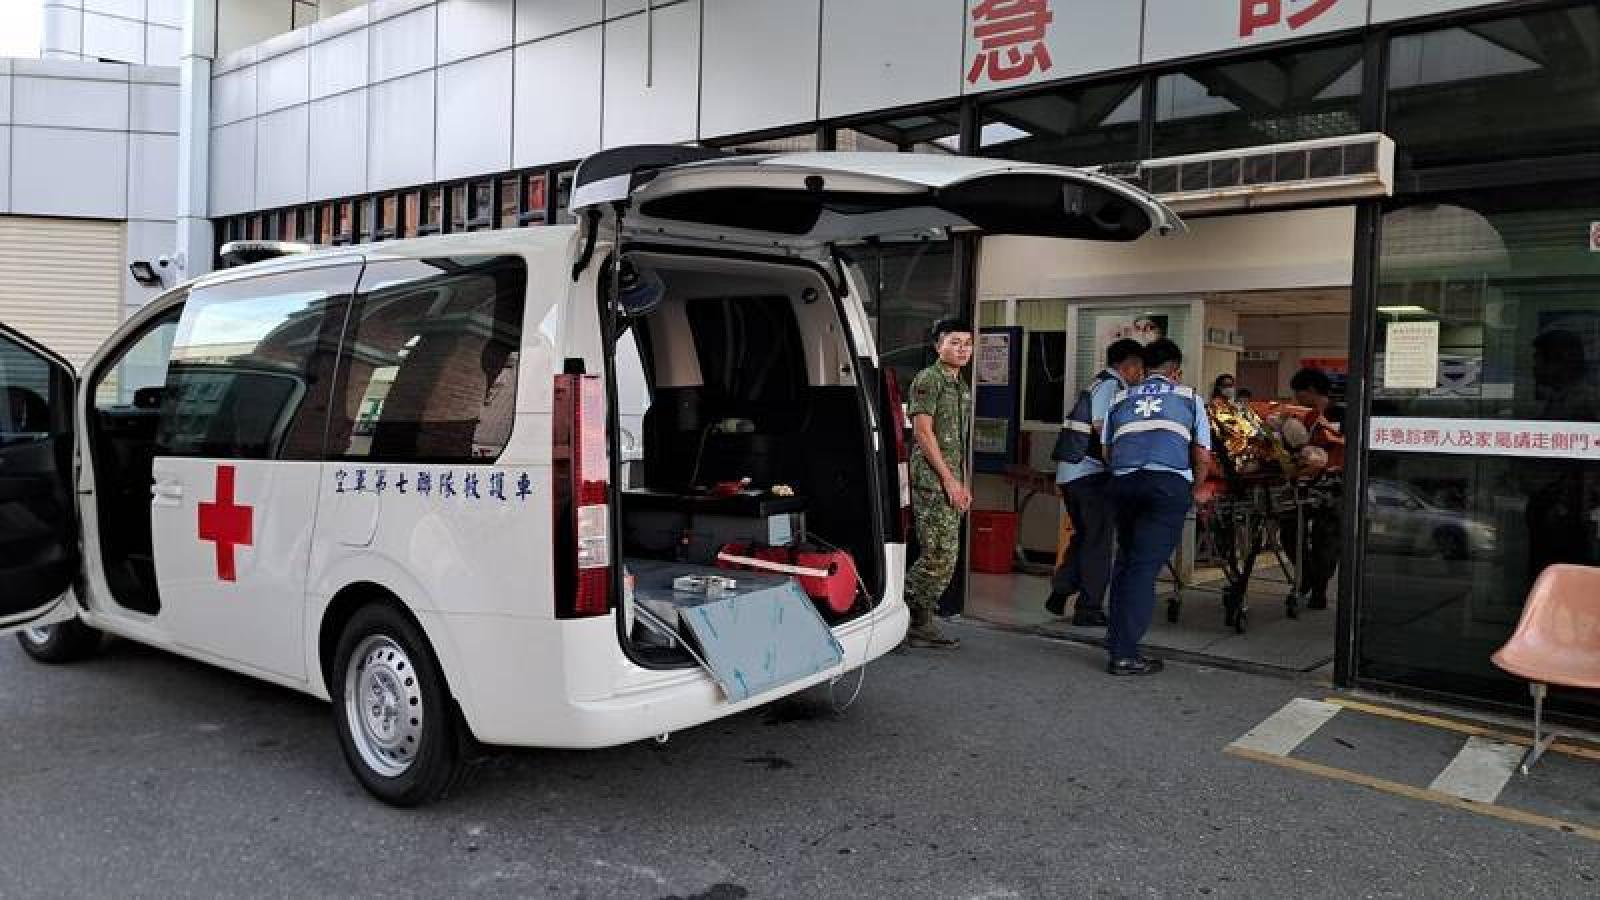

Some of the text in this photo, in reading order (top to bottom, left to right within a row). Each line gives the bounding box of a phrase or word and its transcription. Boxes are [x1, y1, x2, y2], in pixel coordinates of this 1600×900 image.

[336, 469, 532, 501] 空軍第七聯隊救護車
